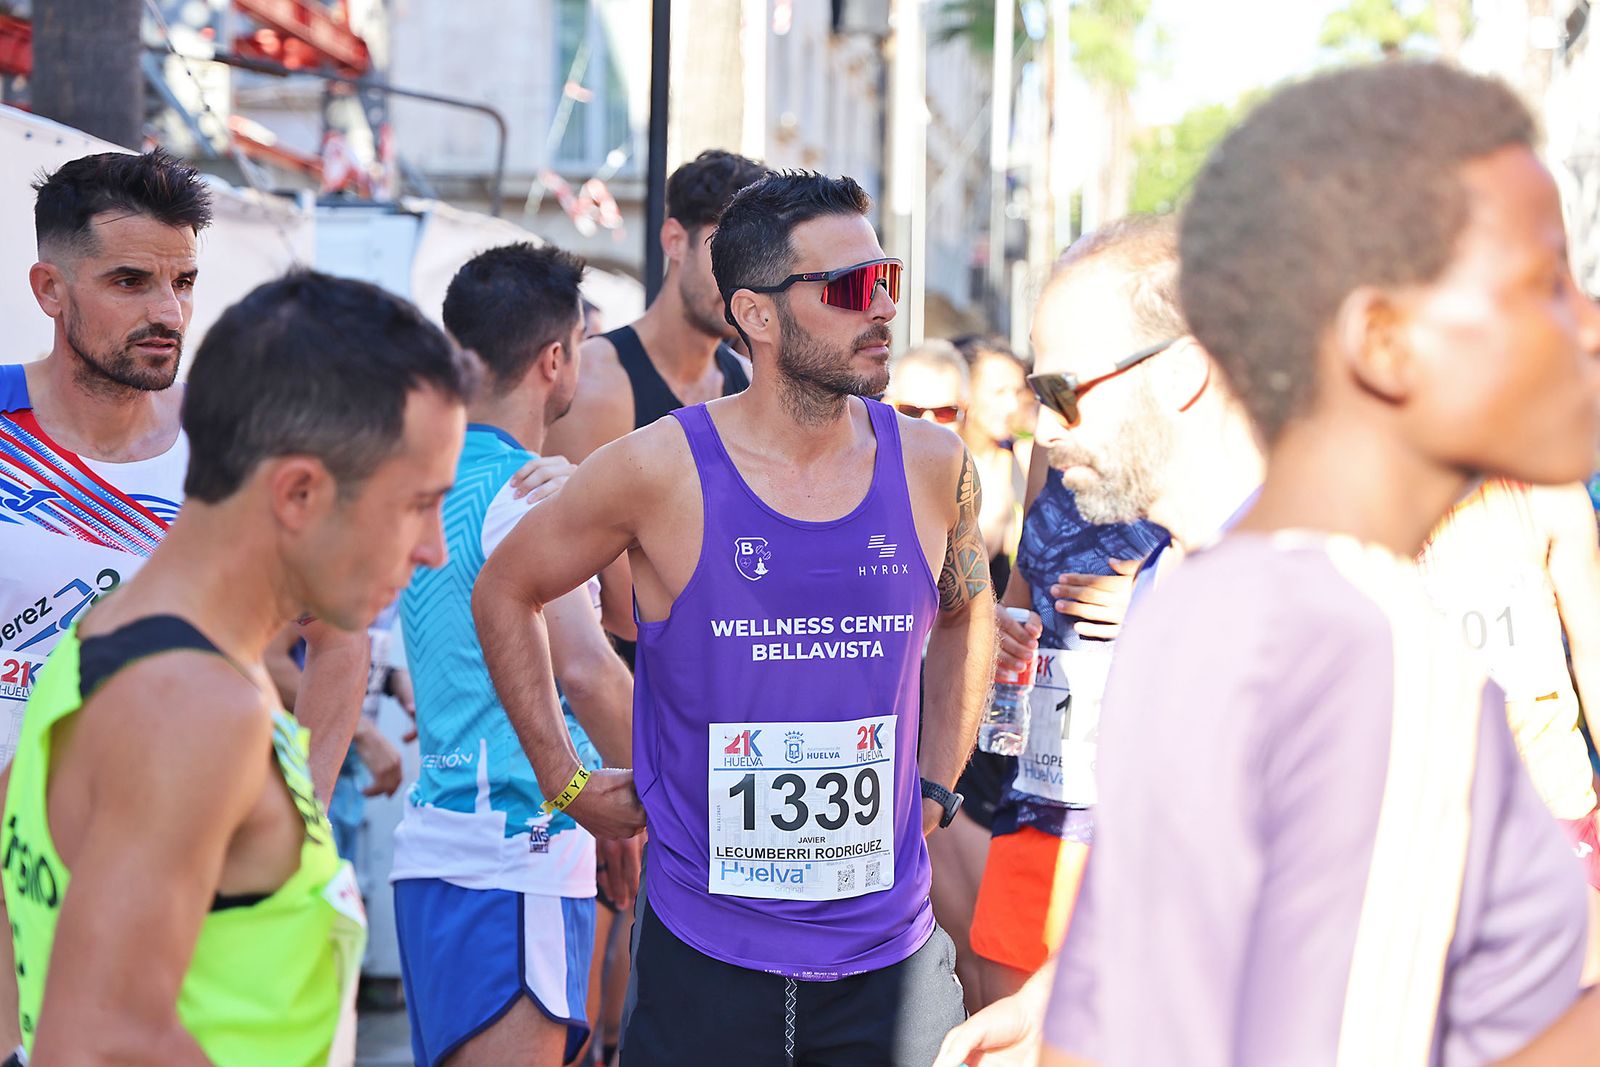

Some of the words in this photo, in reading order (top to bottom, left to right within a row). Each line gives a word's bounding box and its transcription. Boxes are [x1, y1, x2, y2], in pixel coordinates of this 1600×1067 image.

[741, 542, 754, 555] B
[859, 564, 909, 576] HYROX
[711, 617, 835, 637] WELLNESS
[840, 615, 914, 634] CENTER
[752, 640, 884, 661] BELLAVISTA
[1, 659, 43, 687] 21K
[1037, 655, 1055, 678] 21K
[0, 685, 31, 698] HUELV
[724, 729, 763, 757] 21K
[856, 723, 884, 751] 21K
[724, 757, 763, 767] HUELVA
[807, 751, 840, 760] HUELVA
[856, 750, 884, 763] HUELVA
[729, 767, 880, 831] 1339
[716, 846, 810, 860] LECUMBERRI
[815, 839, 882, 859] RODRIGUEZ
[798, 836, 826, 844] JAVIER
[721, 861, 804, 884] Huelva
